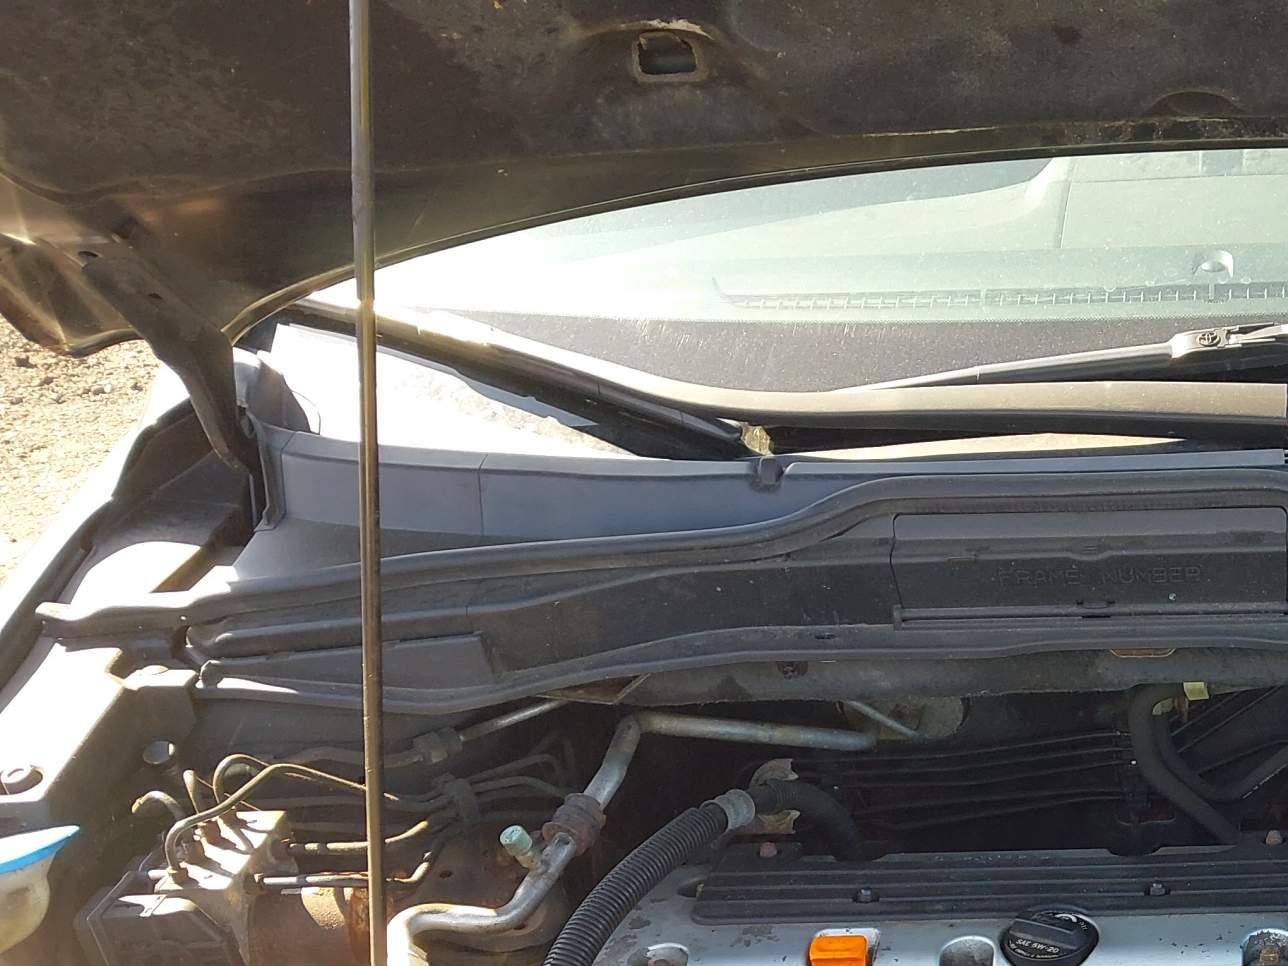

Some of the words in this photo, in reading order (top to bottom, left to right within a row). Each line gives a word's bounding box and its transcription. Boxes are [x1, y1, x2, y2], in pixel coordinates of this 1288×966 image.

[998, 566, 1081, 586] FRAME
[1101, 566, 1200, 585] NUMBER
[1015, 938, 1032, 948] SAE
[1031, 942, 1060, 954] 5W-20
